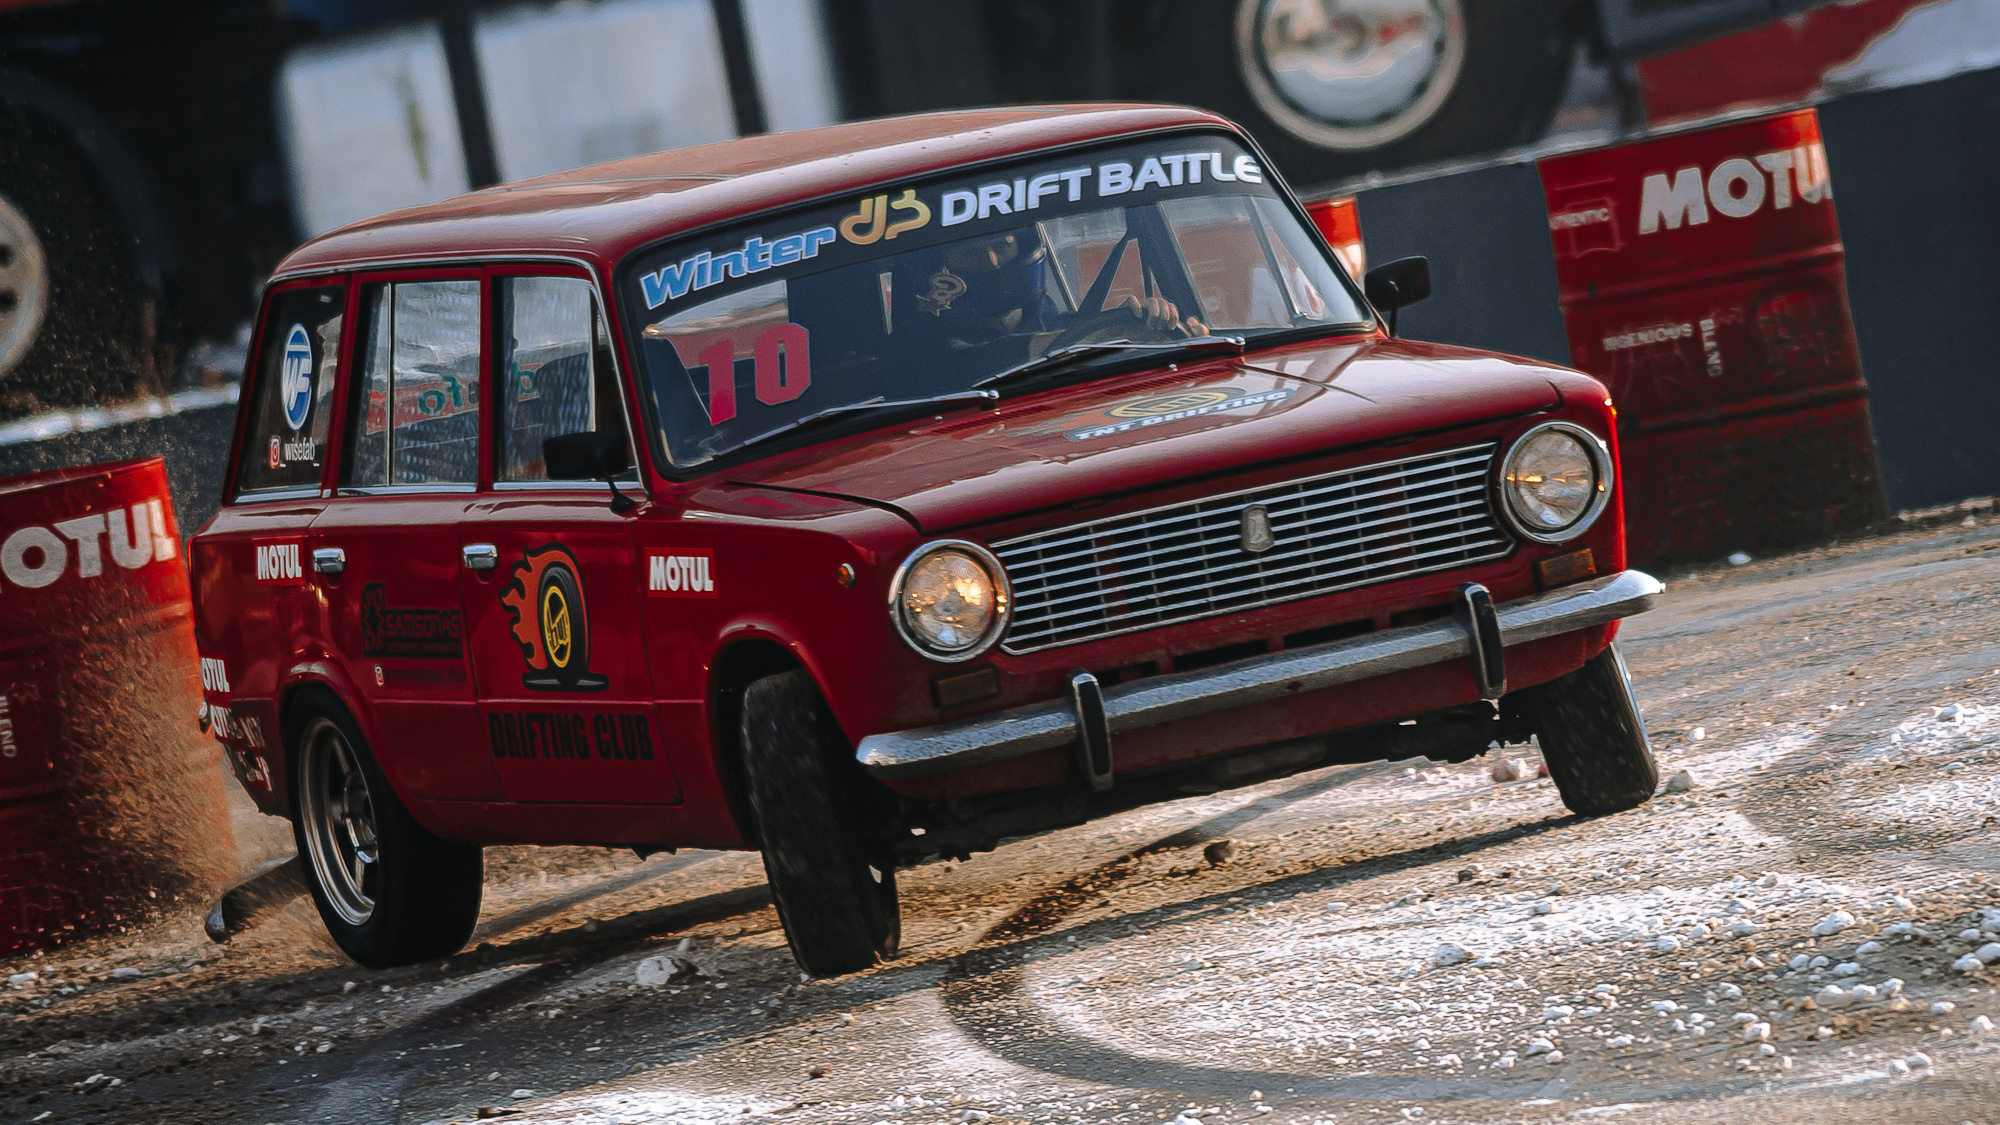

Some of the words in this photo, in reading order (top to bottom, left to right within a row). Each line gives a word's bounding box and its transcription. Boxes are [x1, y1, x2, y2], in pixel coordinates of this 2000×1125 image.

[1637, 142, 1833, 235] MOTU
[640, 227, 836, 310] Winter
[941, 167, 1092, 227] DRIFT
[1099, 152, 1263, 197] BATTLE
[699, 322, 812, 427] 10
[1075, 420, 1140, 441] TNT
[1142, 391, 1288, 427] DRIFTING
[0, 498, 177, 590] OTUL
[257, 543, 303, 580] MOTUL
[650, 555, 714, 593] MOTUL
[201, 656, 231, 693] OTUL
[487, 711, 591, 760] DRIFTING
[592, 712, 656, 761] CLUB
